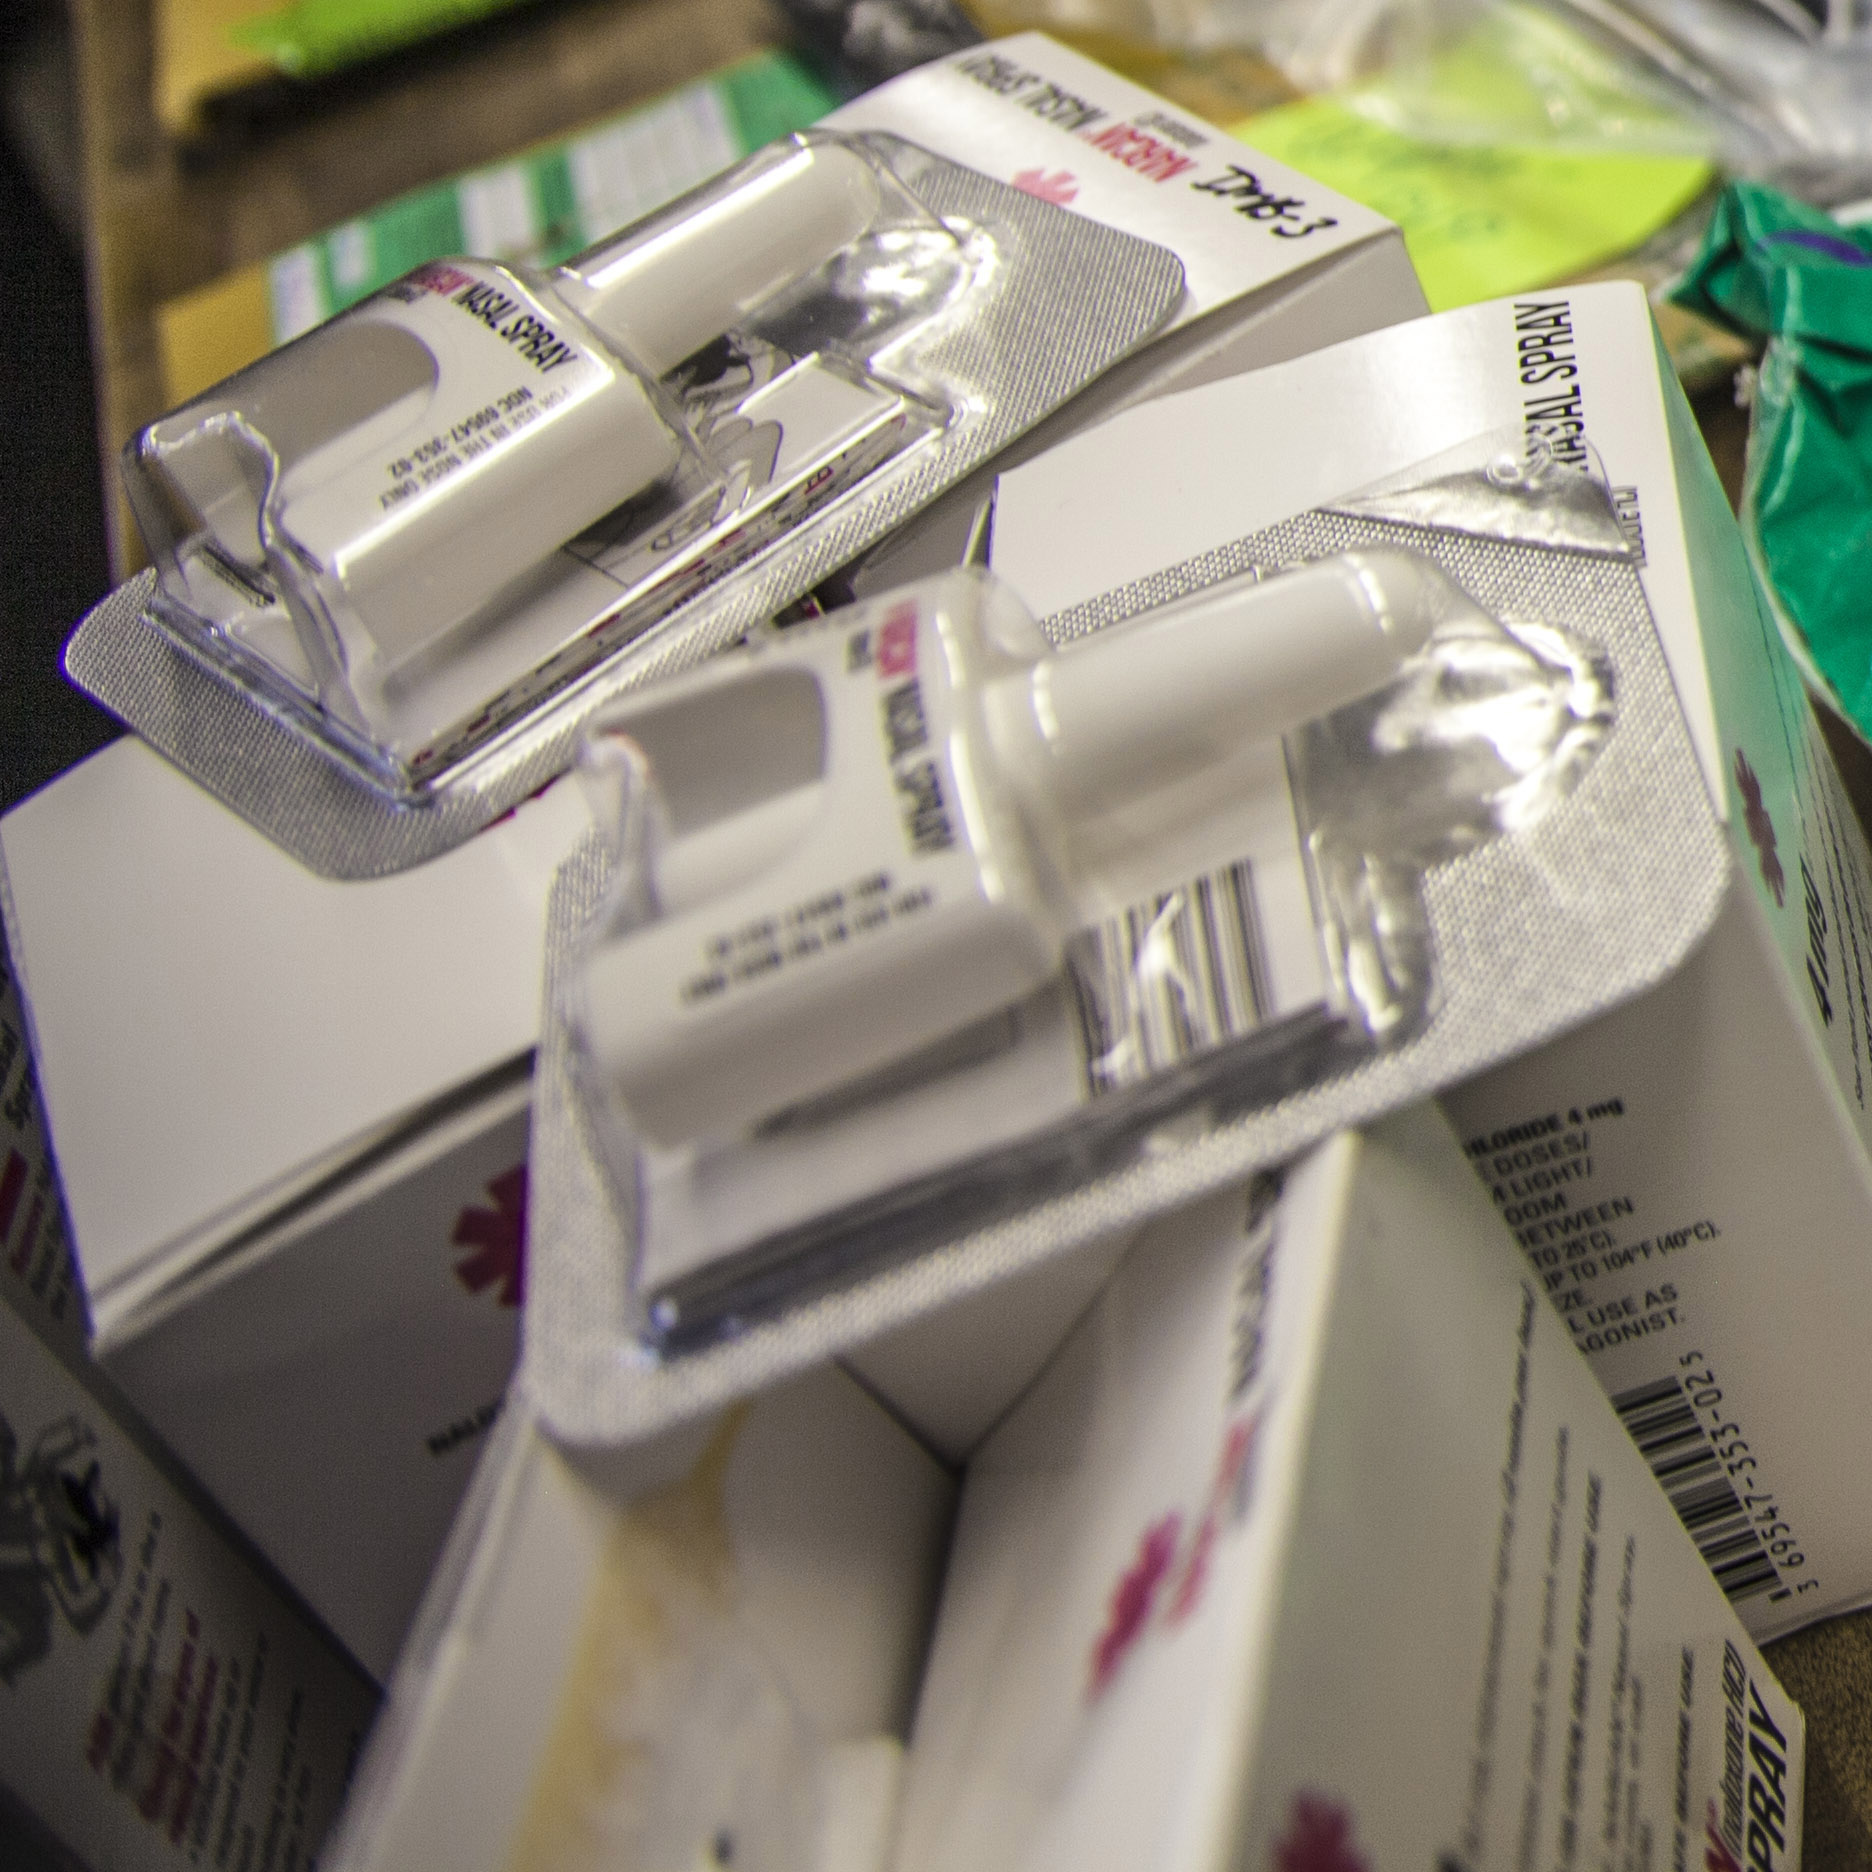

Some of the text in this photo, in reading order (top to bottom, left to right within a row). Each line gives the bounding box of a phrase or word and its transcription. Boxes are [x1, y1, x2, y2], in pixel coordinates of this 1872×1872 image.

[454, 282, 519, 330] NASAL
[500, 315, 578, 373] SPRAY
[1514, 300, 1578, 385] SPRAY
[1587, 1096, 1624, 1121] mg
[1493, 1130, 1590, 1176] DOSES/
[1510, 1156, 1592, 1198] LIGHT/
[1568, 1261, 1597, 1283] TO
[1587, 1296, 1639, 1327] USE
[1644, 1282, 1678, 1309] AS
[1747, 1679, 1788, 1872] PRAY
